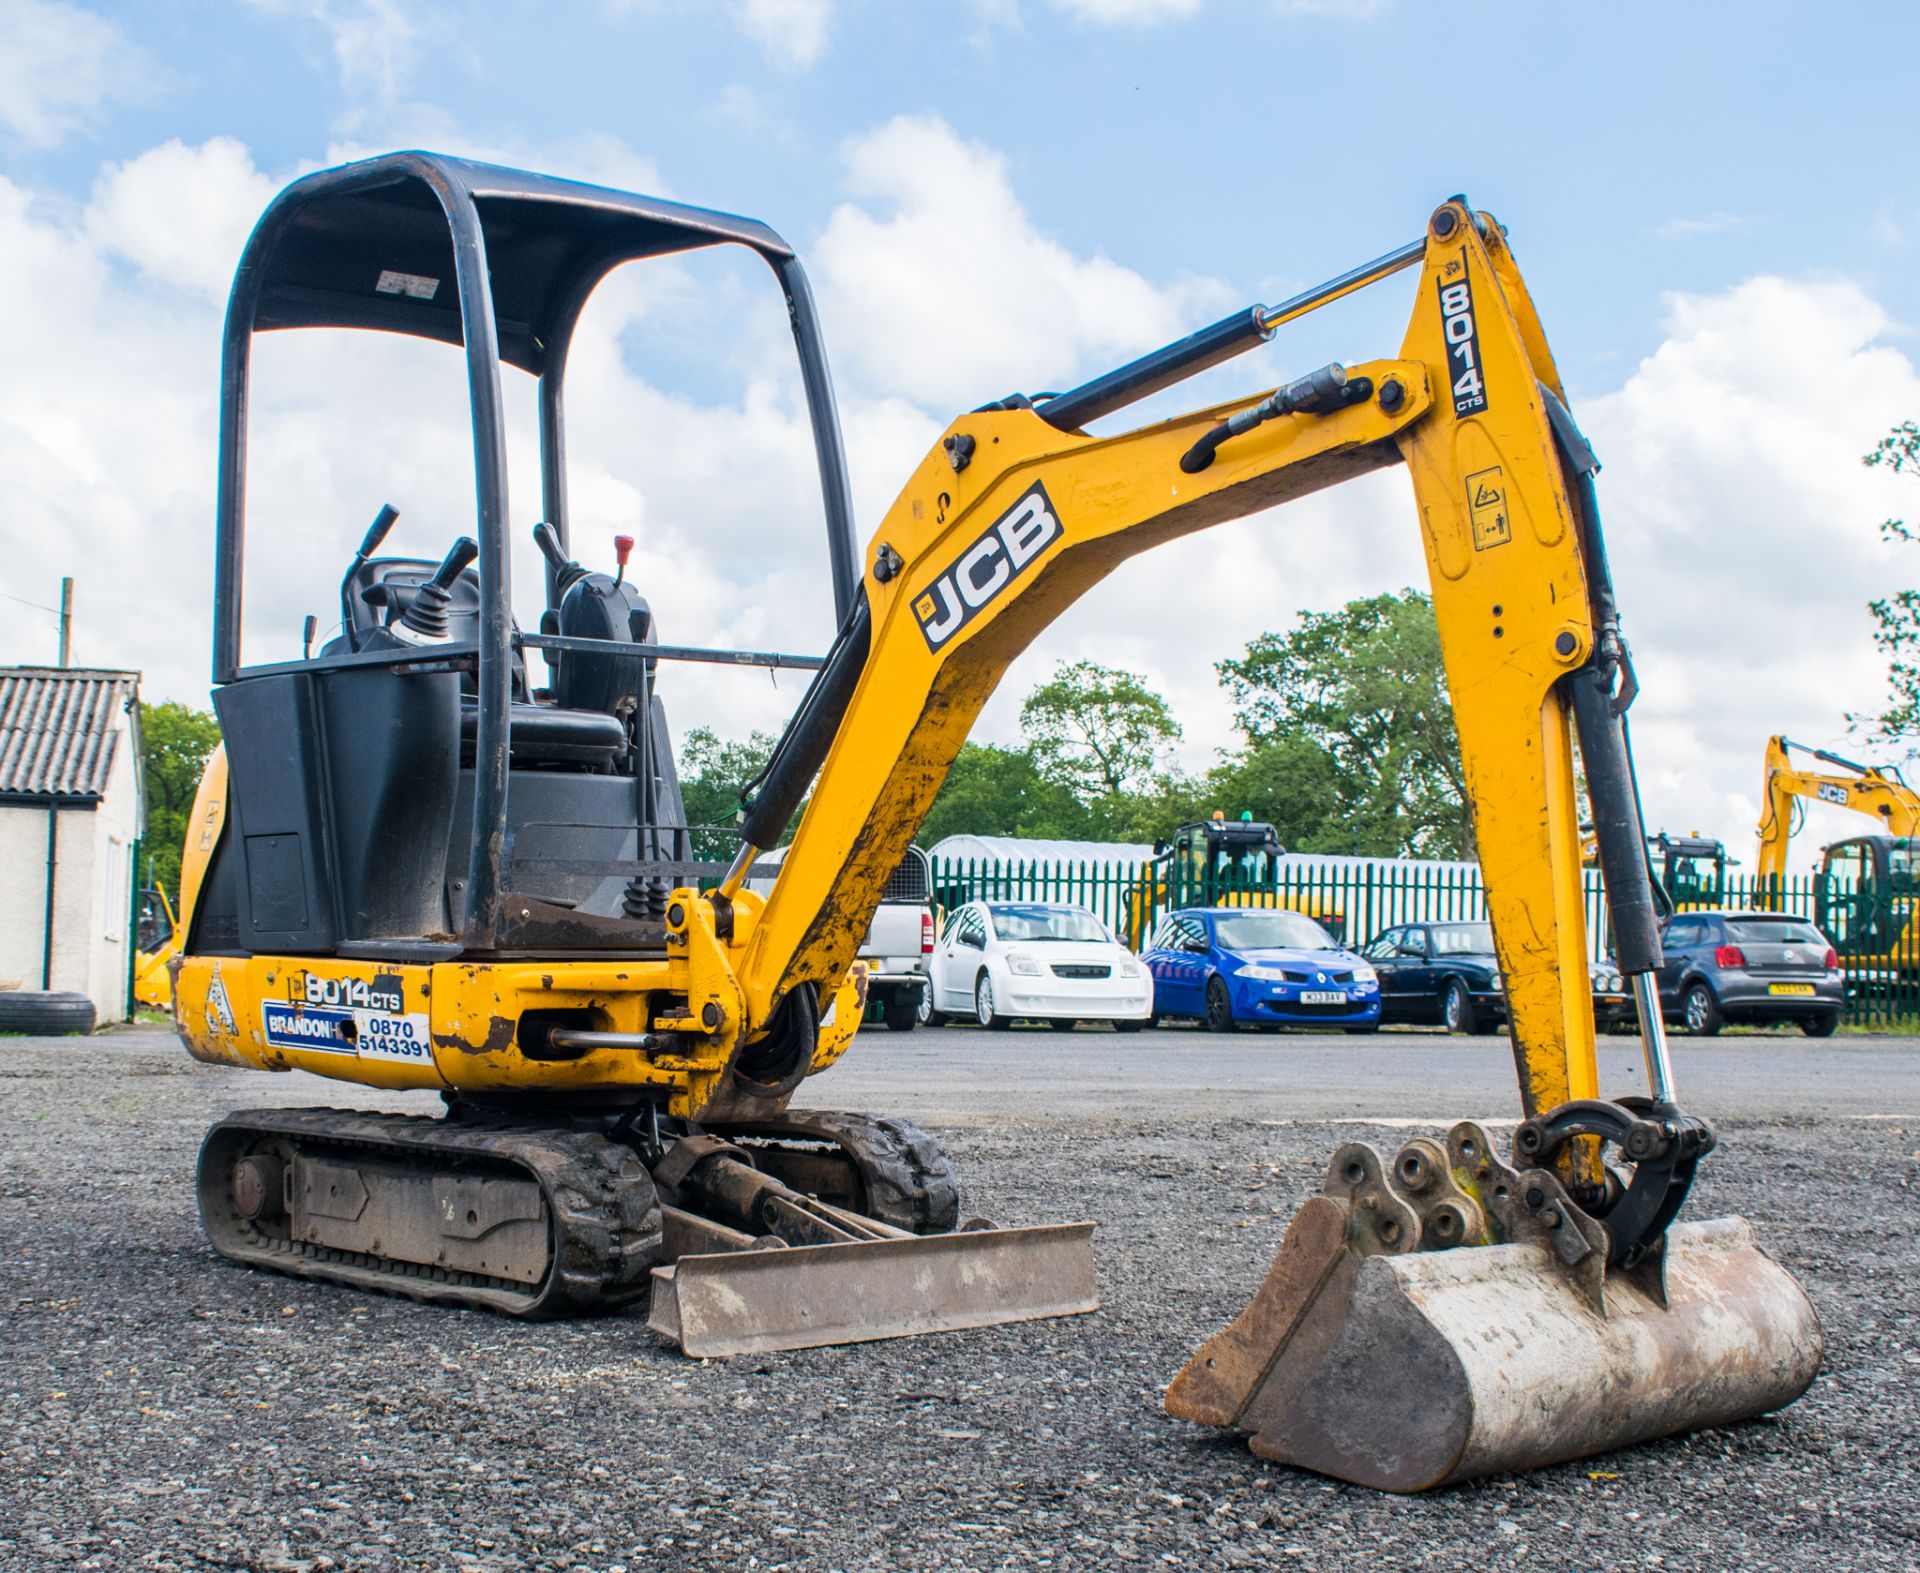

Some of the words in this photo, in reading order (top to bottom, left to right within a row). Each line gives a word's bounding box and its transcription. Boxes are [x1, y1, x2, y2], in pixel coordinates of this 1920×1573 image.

[1441, 283, 1482, 397] 8014
[1456, 395, 1483, 412] CTS
[925, 493, 1056, 642] JCB
[1818, 784, 1847, 804] JCB
[305, 973, 371, 1007] 8014
[371, 992, 400, 1010] CTS
[370, 1018, 414, 1038] 0870
[359, 1034, 433, 1058] 5143391
